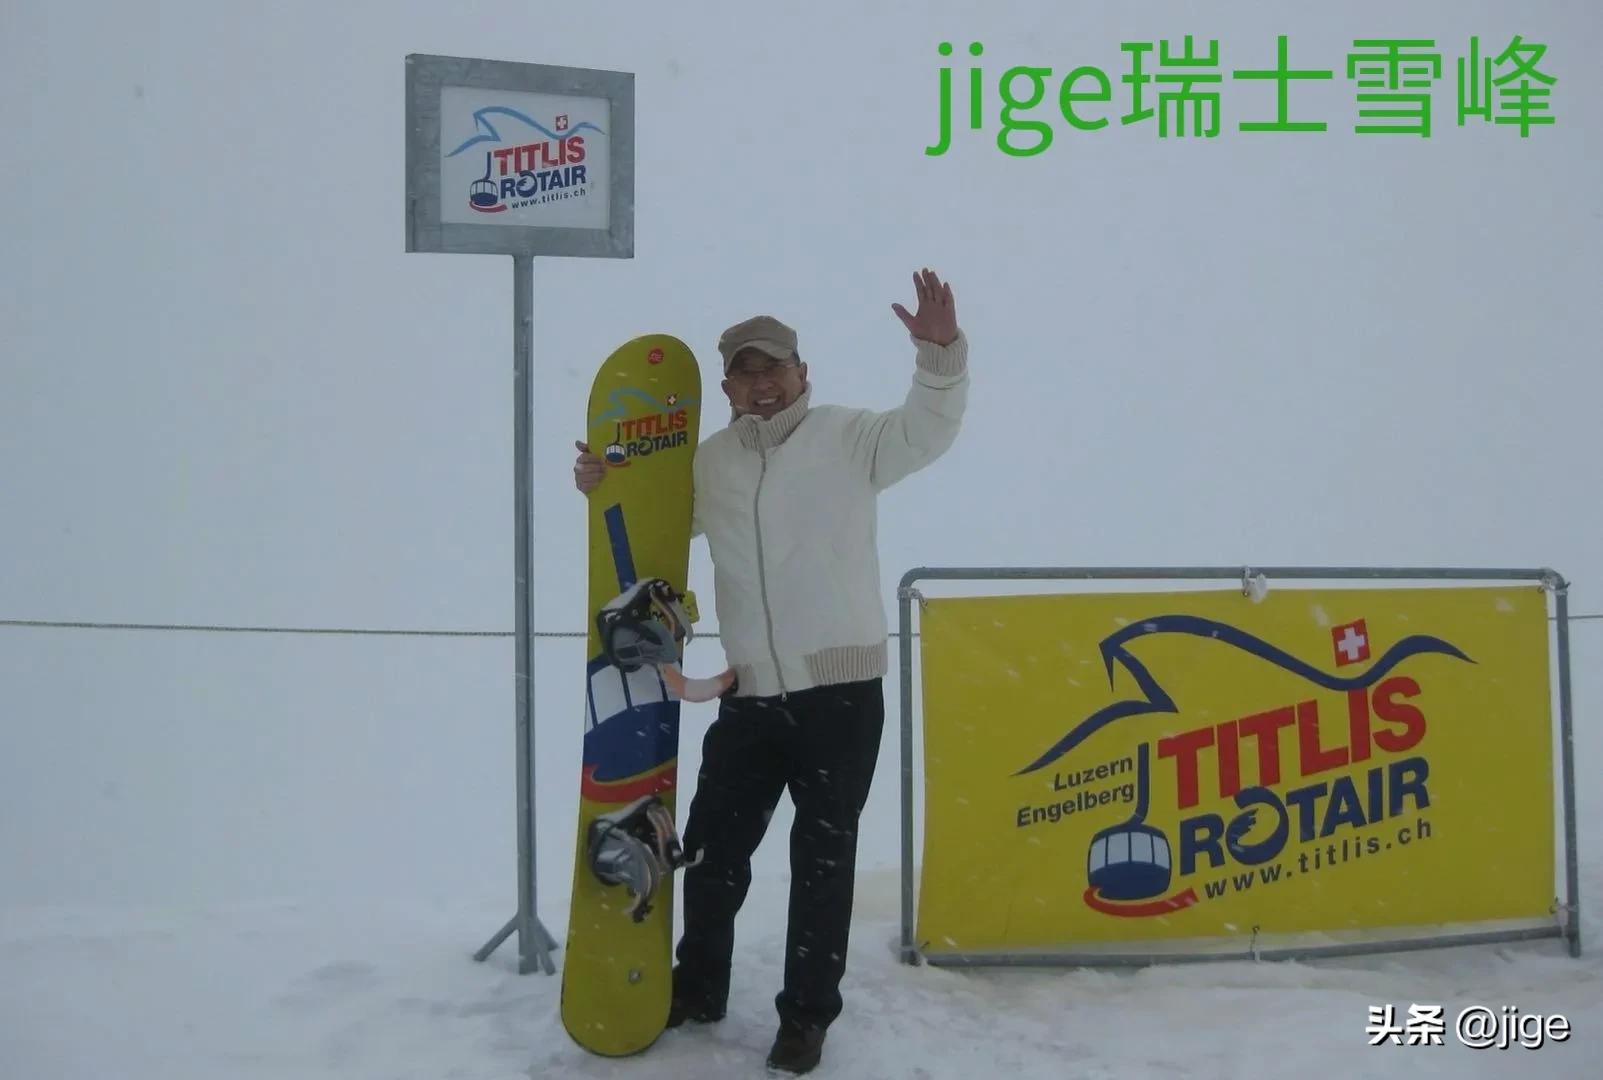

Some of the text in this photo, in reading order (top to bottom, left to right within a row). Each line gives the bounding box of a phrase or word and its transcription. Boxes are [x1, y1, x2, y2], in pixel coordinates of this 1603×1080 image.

[493, 136, 586, 176] TITLIS
[500, 165, 586, 200] ROTAIR
[511, 188, 586, 209] www.titlis.ch
[622, 409, 688, 440] TITLIS
[626, 431, 688, 457] ROTAIR
[1157, 676, 1427, 810] TITLIS
[1053, 756, 1134, 792] Luzern
[1016, 783, 1135, 827] Engelberg
[1179, 757, 1431, 876] ROTAIR
[1205, 817, 1432, 899] www.titlis.ch
